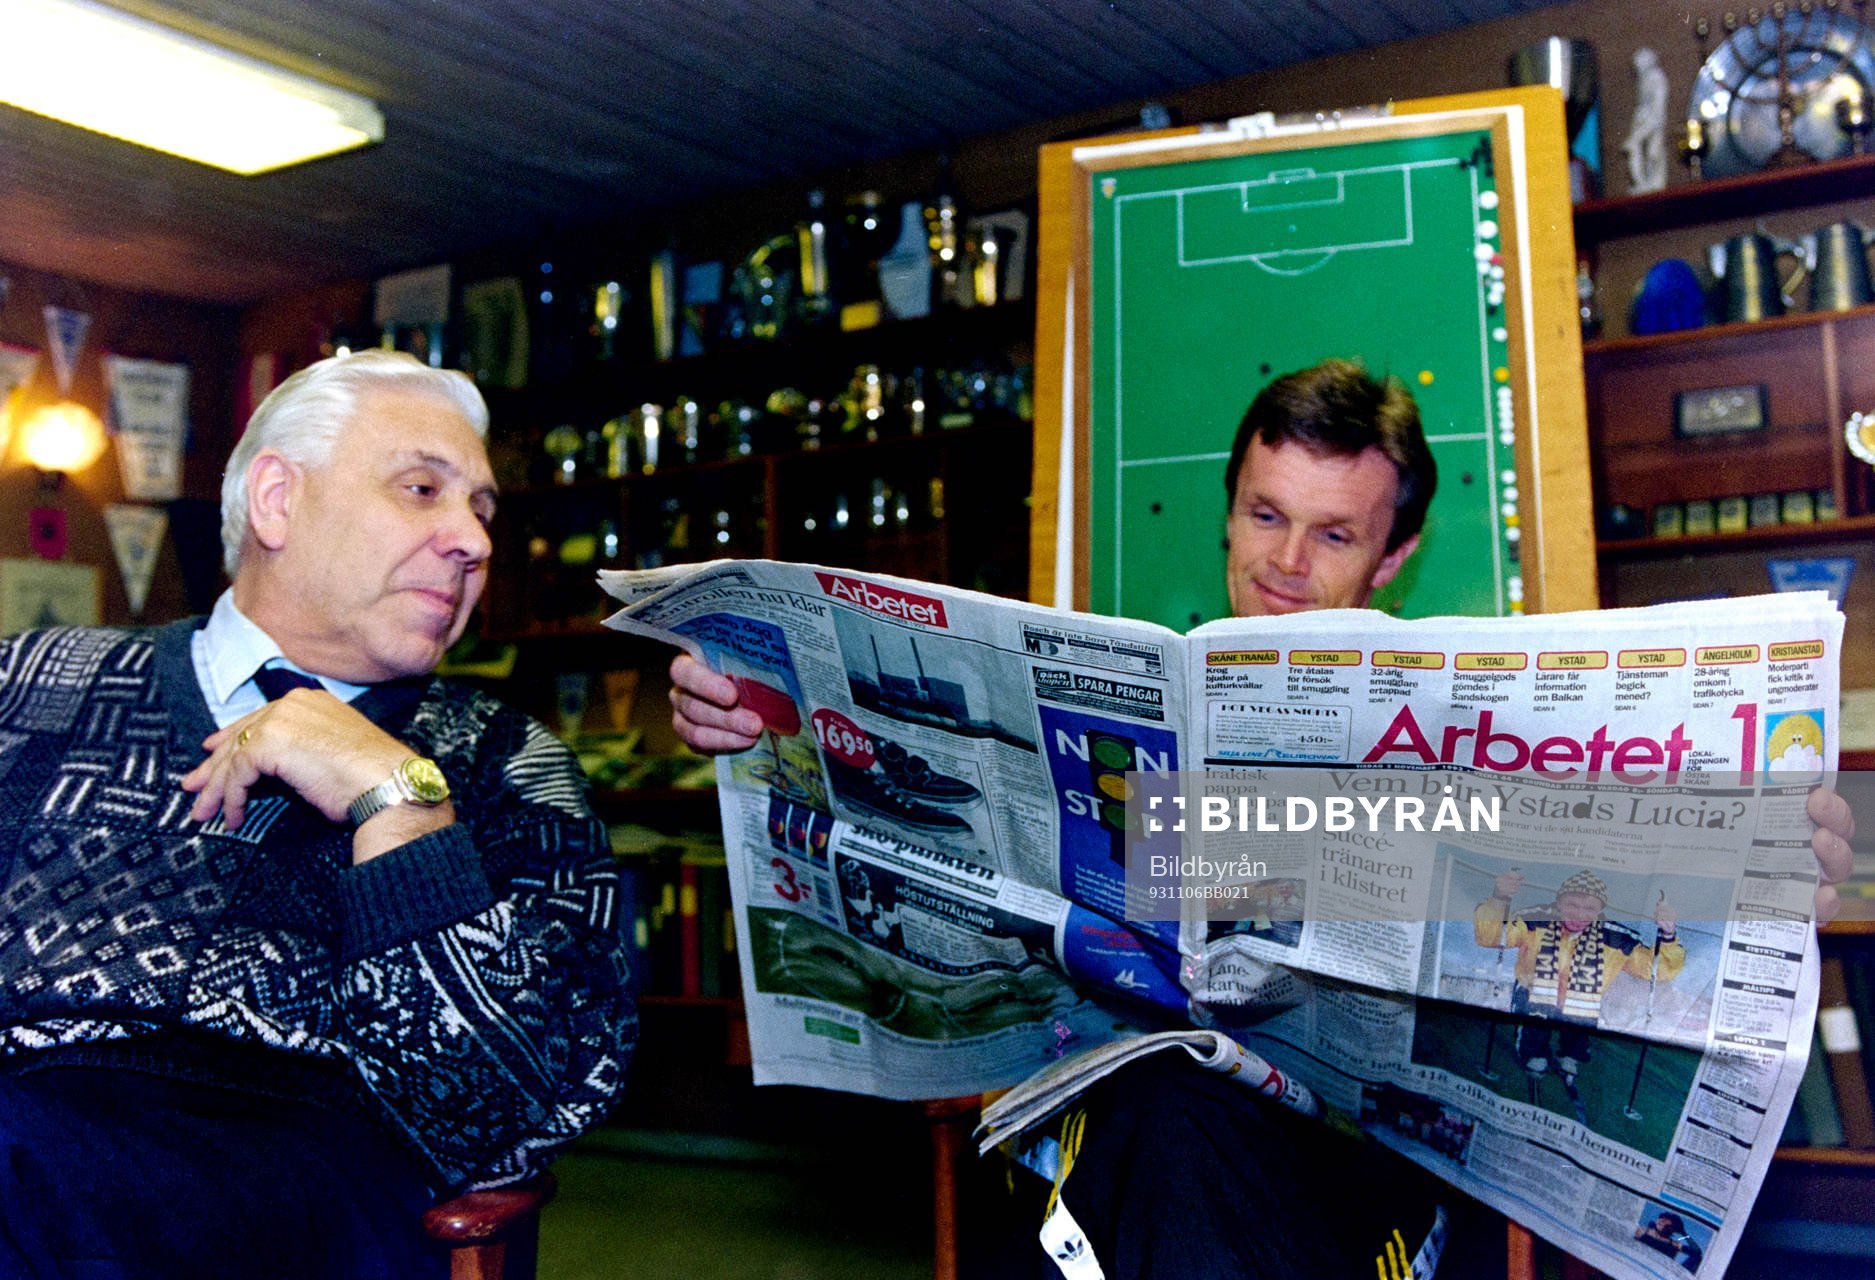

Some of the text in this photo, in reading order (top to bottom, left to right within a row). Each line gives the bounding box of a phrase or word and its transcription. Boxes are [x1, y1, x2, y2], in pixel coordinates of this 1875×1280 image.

[832, 576, 938, 624] Arbetet
[786, 593, 828, 618] klar
[1023, 623, 1051, 635] Bosch
[1064, 629, 1083, 641] inte
[1084, 634, 1107, 645] bara
[1703, 649, 1753, 661] ÄNGELHOLM
[1771, 645, 1821, 657] KRISTIANSTAD
[1209, 652, 1277, 663] SKÅNE TRANÅS
[1310, 654, 1339, 662] YSTAD
[1393, 655, 1422, 664] YSTAD
[1476, 656, 1505, 666] YSTAD
[1558, 656, 1586, 665] YSTAD
[1638, 653, 1666, 664] YSTAD
[1206, 667, 1229, 675] Krog
[1288, 666, 1335, 675] Tre åtalas
[1694, 667, 1730, 678] 28-åring
[1767, 662, 1809, 673] Moderparti
[1236, 674, 1249, 682] på
[1370, 668, 1404, 678] 32-årig
[1453, 672, 1517, 683] Smuggelgods
[1535, 672, 1580, 681] Lärare får
[1616, 670, 1669, 681] Tjänsteman
[1767, 673, 1815, 683] fick kritik av
[1287, 675, 1332, 684] för försök
[1369, 678, 1419, 688] smugglare
[1693, 679, 1727, 688] omkom
[1077, 677, 1113, 695] SPARA
[1115, 685, 1161, 703] PENGAR
[1206, 682, 1263, 690] kulturkvällar
[1287, 684, 1350, 694] till smuggling
[1452, 682, 1496, 692] gömdes i
[1534, 682, 1587, 691] information
[1615, 681, 1647, 692] begick
[1767, 683, 1819, 695] ungmoderater
[1369, 687, 1412, 697] ertappad
[1451, 692, 1509, 702] Sandskogen
[1614, 691, 1652, 701] mened?
[1693, 688, 1744, 699] trafikolycka
[1551, 693, 1584, 702] Balkan
[1360, 703, 1758, 786] Arbetet 1
[1688, 757, 1730, 765] TIDNINGEN
[1686, 764, 1703, 772] FÖR
[1204, 766, 1269, 781] Irakisk
[1684, 771, 1711, 779] ÖSTRA
[1683, 778, 1711, 787] SKÅNE
[1203, 783, 1258, 797] pappa
[1329, 771, 1409, 794] Vem
[1421, 773, 1483, 803] blir
[1491, 784, 1615, 822] Ystads
[1625, 796, 1746, 831] Lucia?
[1576, 824, 1644, 841] kandidaterna
[1322, 829, 1396, 852] Succé-
[1321, 844, 1414, 881] tränaren
[1319, 865, 1409, 904] i klistret
[895, 884, 995, 929] HÖSTUTSTÄLLNING
[1740, 904, 1774, 914] DAGENS
[1742, 984, 1776, 994] MÅLTIPS
[1733, 1035, 1759, 1045] LOTTO
[1499, 1099, 1566, 1136] nycklar
[1568, 1121, 1578, 1139] i
[1580, 1126, 1654, 1175] hemmet
